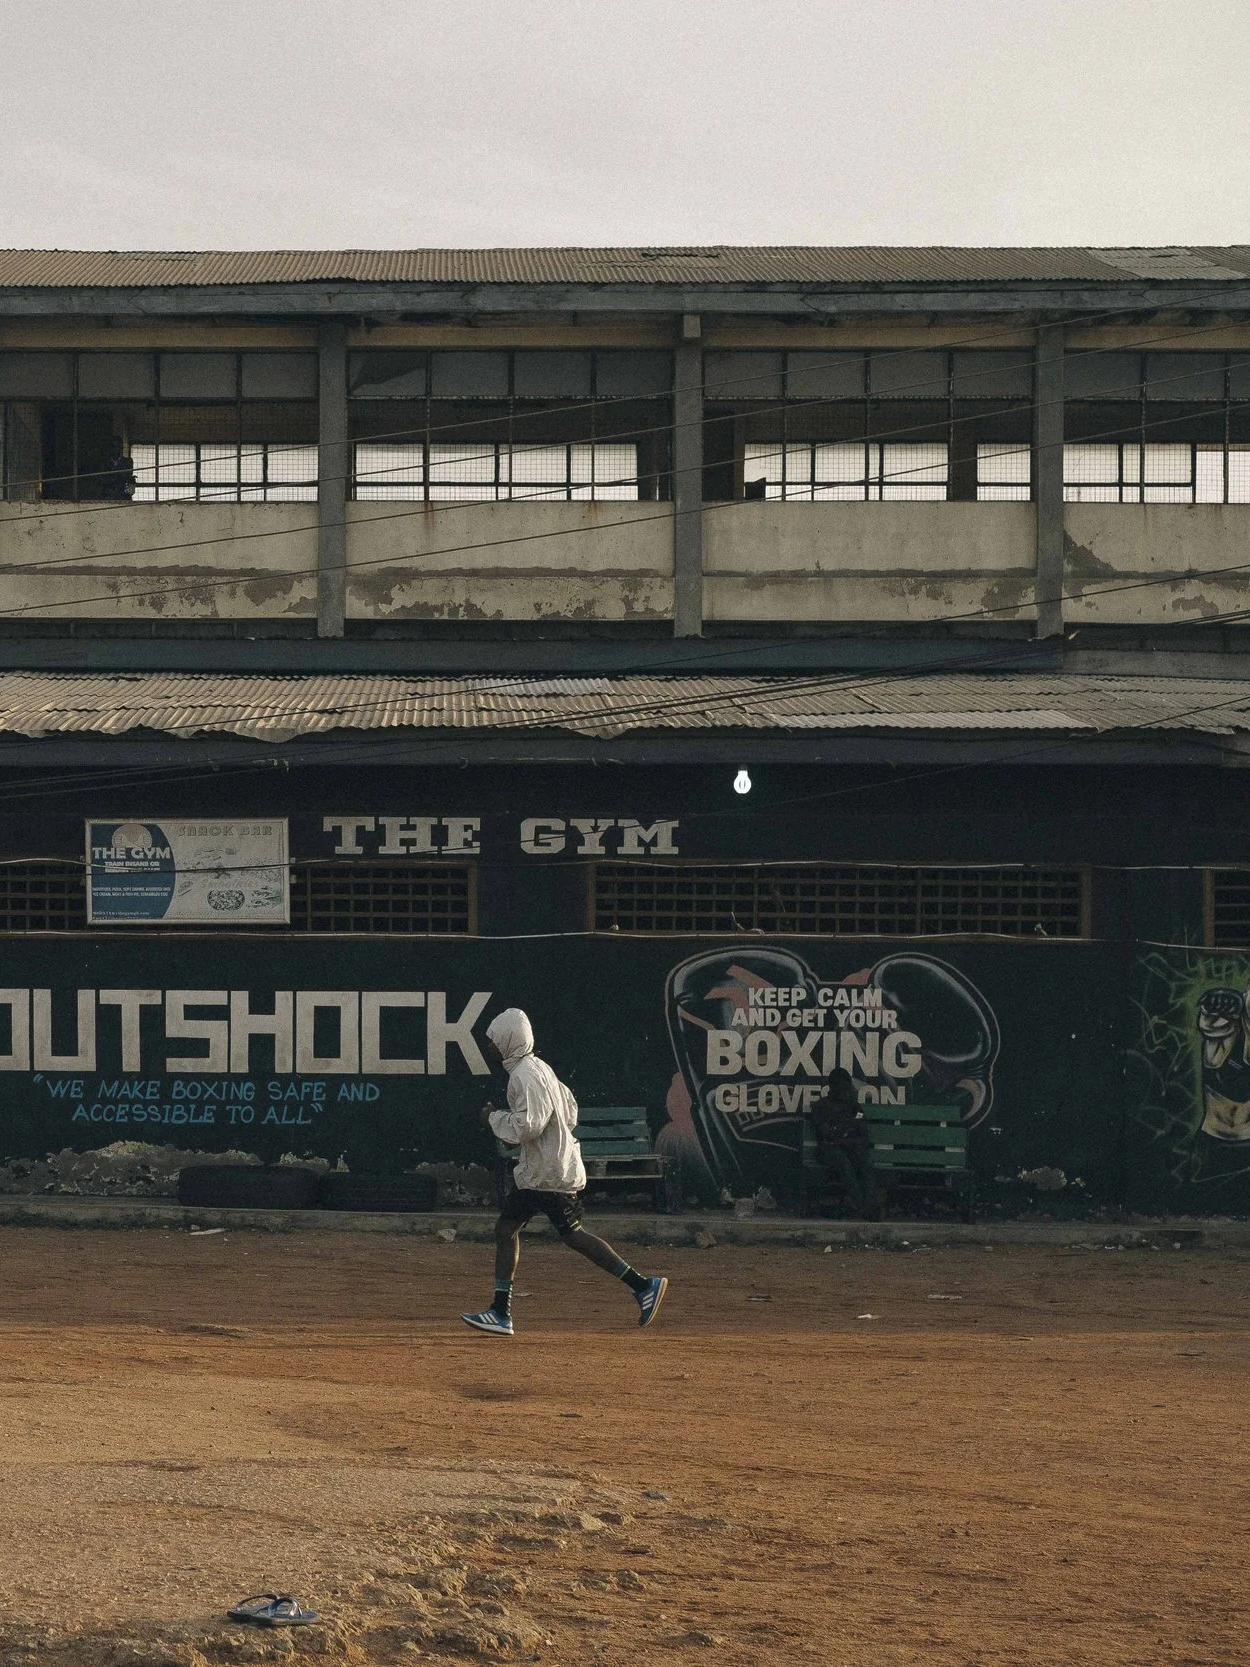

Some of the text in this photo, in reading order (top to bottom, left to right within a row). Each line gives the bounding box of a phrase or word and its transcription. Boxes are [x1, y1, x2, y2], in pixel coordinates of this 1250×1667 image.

[323, 816, 679, 854] THE GYM
[92, 847, 170, 859] THE GYM
[749, 987, 883, 1008] KEEP CALM
[731, 1008, 898, 1029] AND GET YOUR
[706, 1029, 922, 1078] BOXING
[98, 1079, 161, 1100] MAKE
[172, 1080, 256, 1102] BOXING
[267, 1081, 327, 1101] SAFE
[337, 1082, 381, 1102] AND
[857, 1084, 906, 1105] ON
[71, 1103, 217, 1124] ACCESSIBLE
[226, 1105, 255, 1124] TO
